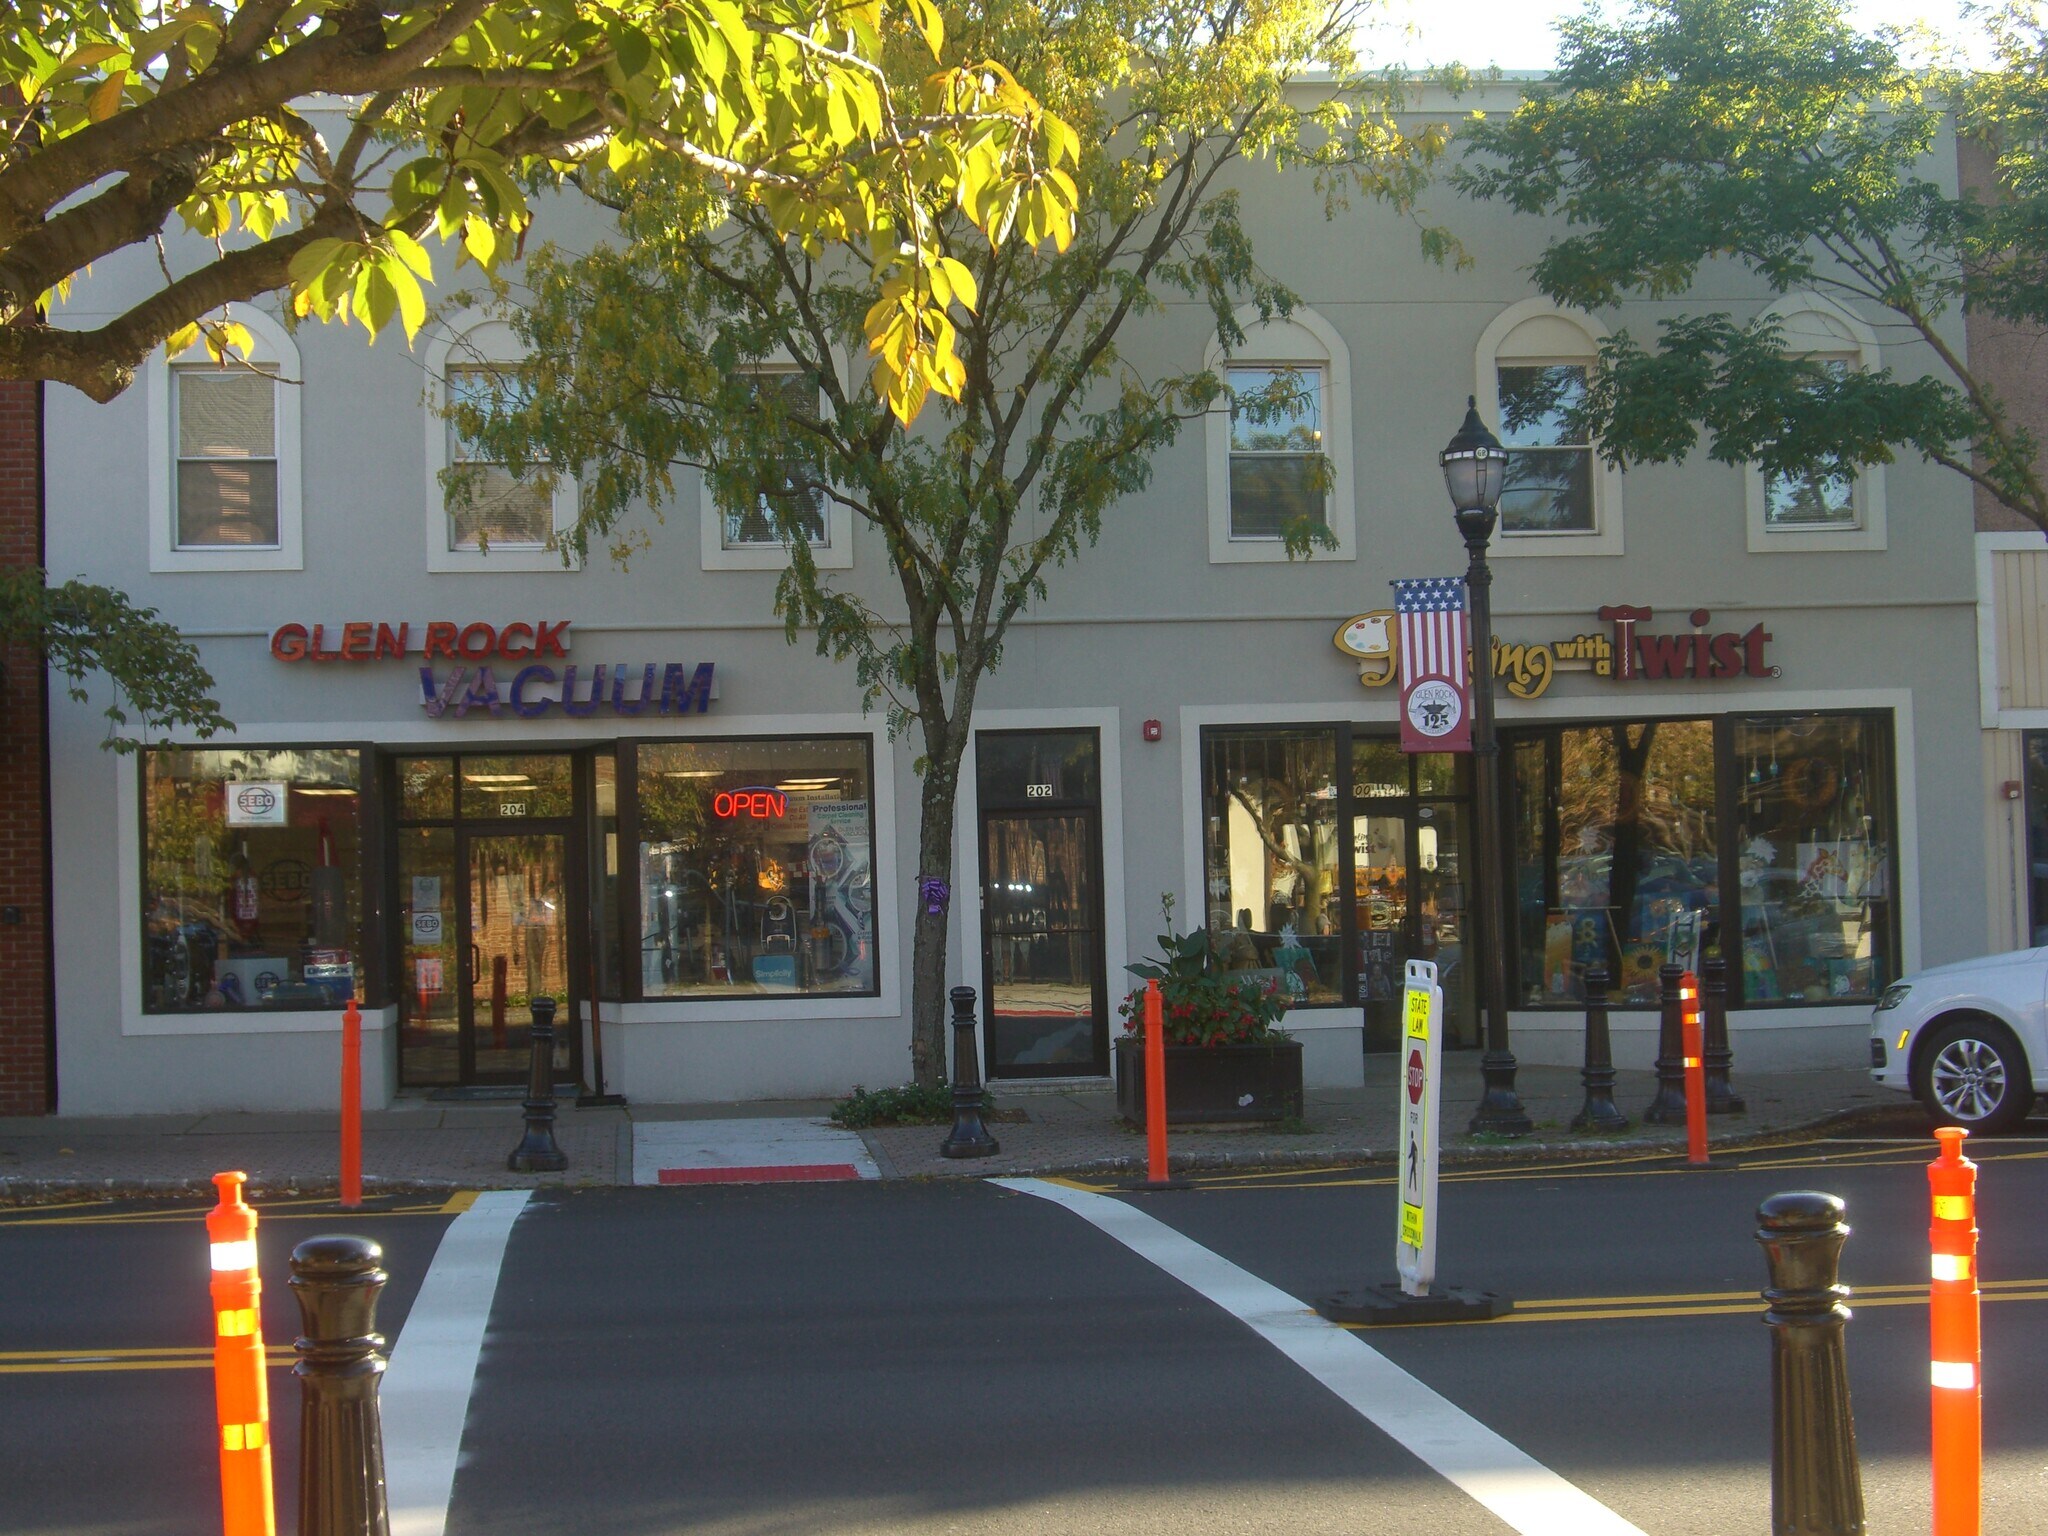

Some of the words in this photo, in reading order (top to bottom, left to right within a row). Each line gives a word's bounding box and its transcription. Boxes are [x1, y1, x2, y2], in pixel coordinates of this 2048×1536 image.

[270, 621, 409, 663] GLEN
[423, 620, 572, 662] ROCK
[1553, 633, 1611, 659] with
[1599, 604, 1773, 681] Twist
[1596, 658, 1611, 676] a
[419, 662, 715, 720] VACUUM
[1415, 690, 1434, 699] GLEN
[1422, 714, 1450, 729] 125
[1028, 785, 1052, 796] 202
[239, 795, 274, 806] SEBO
[714, 792, 785, 818] OPEN
[812, 802, 868, 813] Professional
[501, 803, 525, 816] 204
[415, 920, 438, 929] SEBO
[754, 968, 792, 979] Simplicity
[1411, 997, 1427, 1015] STATE
[1412, 1017, 1424, 1034] LAW
[1408, 1066, 1423, 1088] STOP
